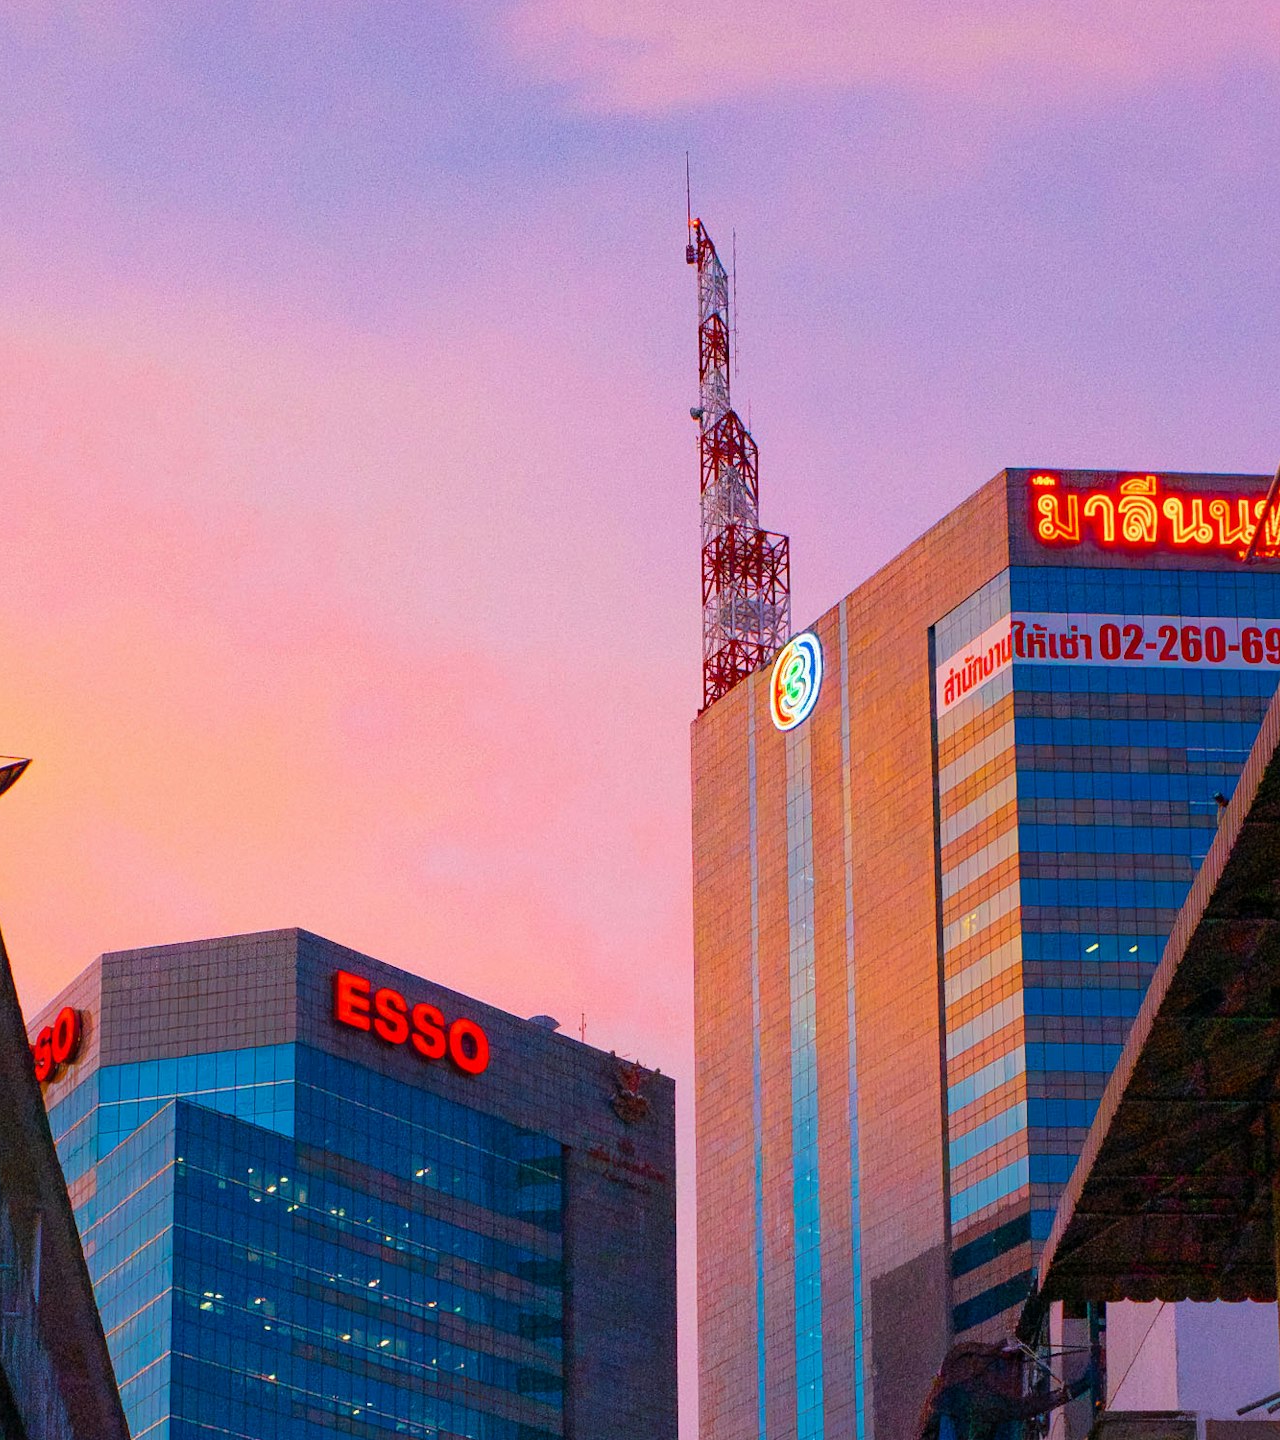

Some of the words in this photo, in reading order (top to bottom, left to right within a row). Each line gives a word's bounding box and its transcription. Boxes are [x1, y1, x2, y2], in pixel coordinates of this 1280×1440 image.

[942, 631, 1011, 707] สำนักงาน
[1010, 620, 1092, 660] ให้เช่า
[29, 1006, 78, 1083] SO
[333, 969, 491, 1076] ESSO
